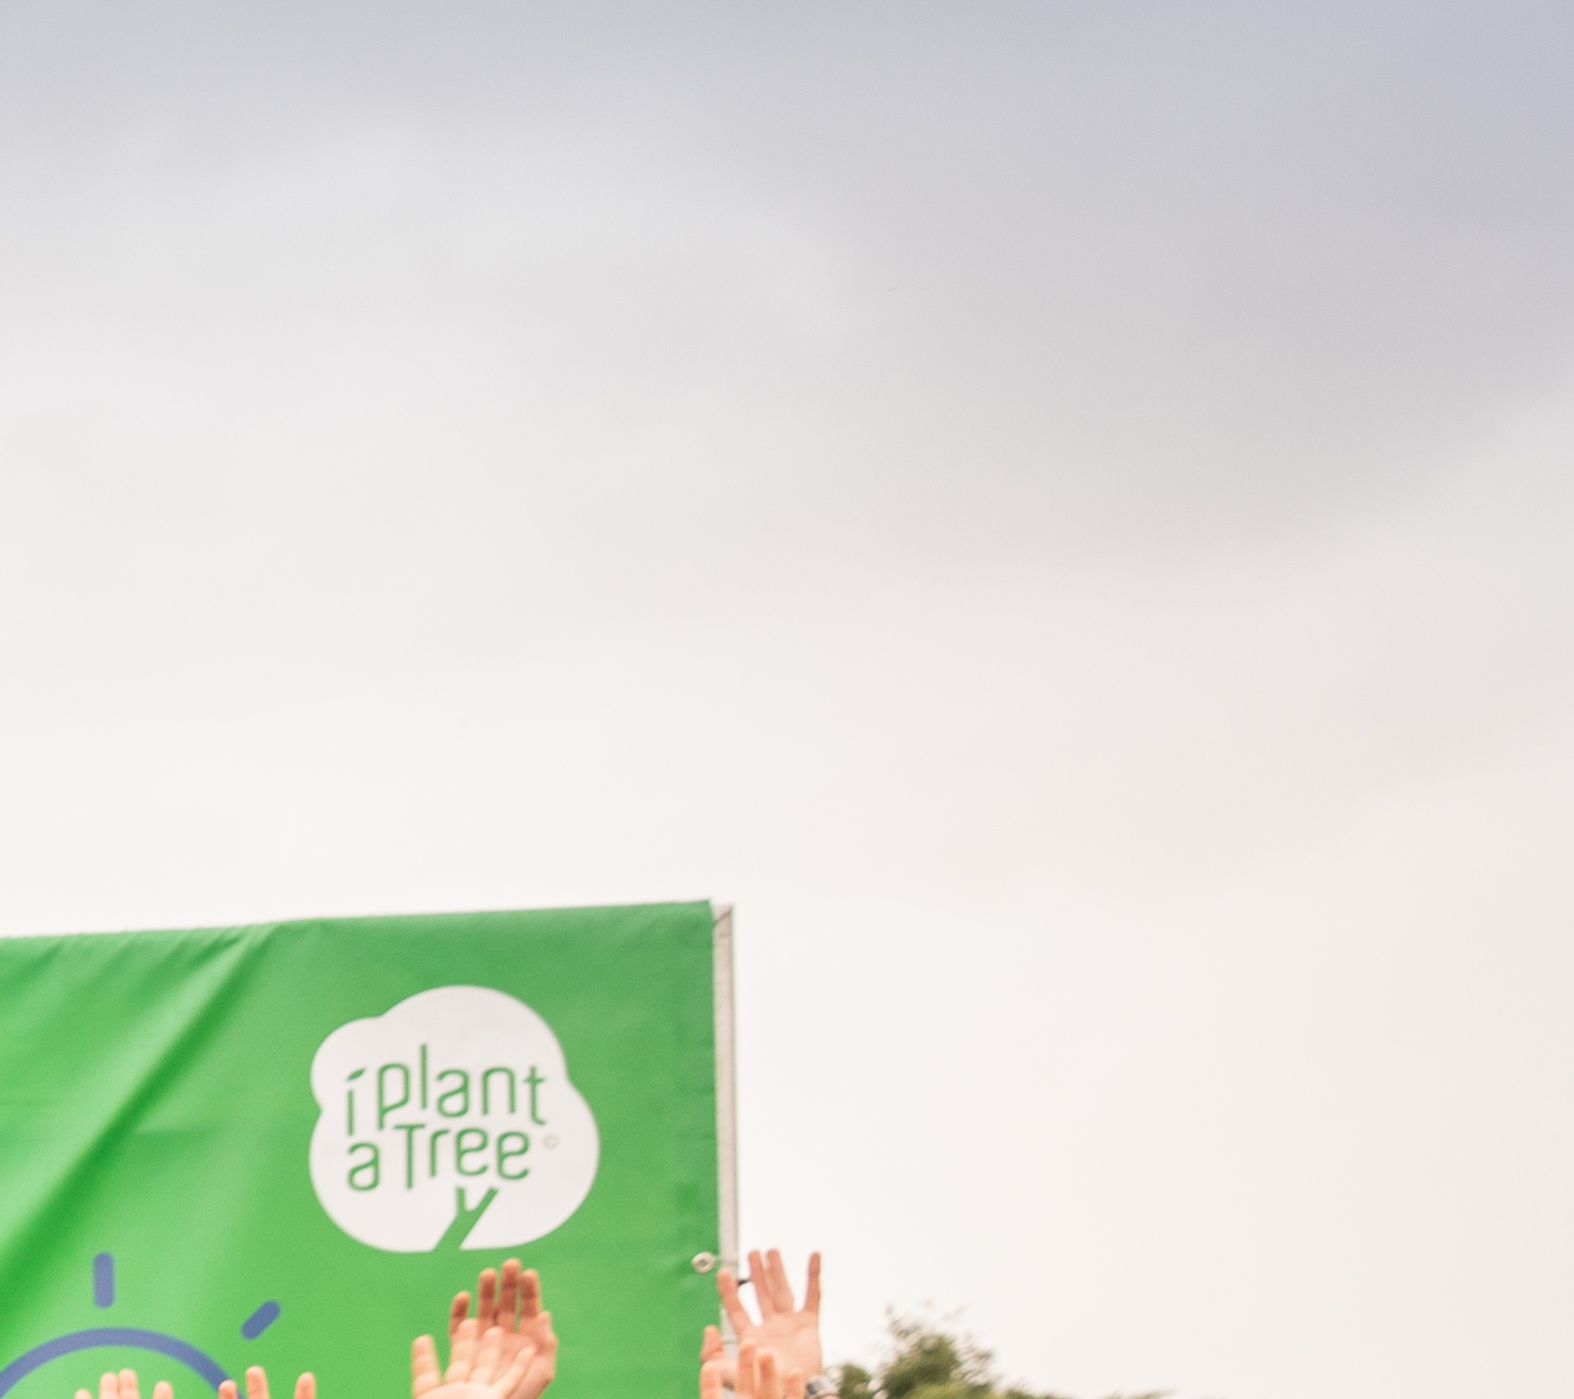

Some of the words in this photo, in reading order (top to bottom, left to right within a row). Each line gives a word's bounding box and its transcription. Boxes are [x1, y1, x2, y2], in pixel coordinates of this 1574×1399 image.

[377, 1043, 546, 1131] plant
[347, 1141, 380, 1192] a
[392, 1123, 531, 1192] Tree
